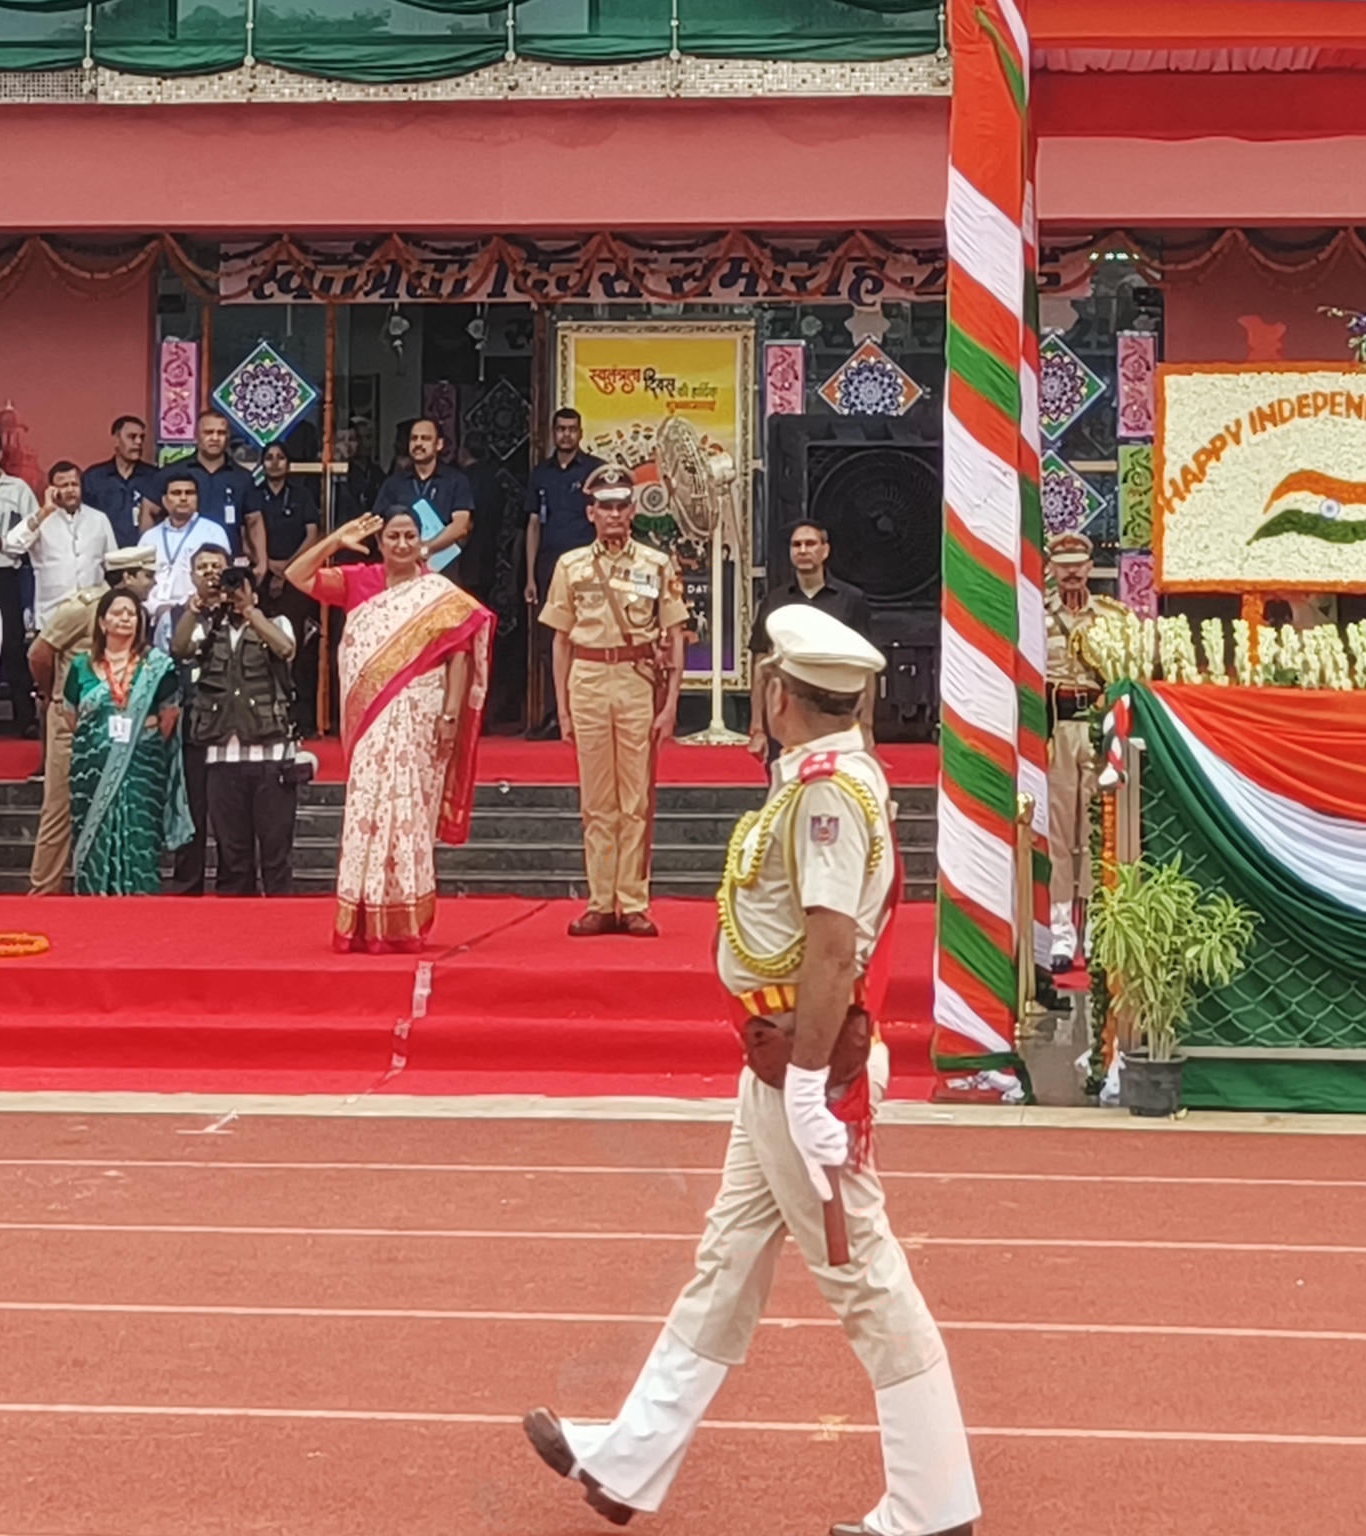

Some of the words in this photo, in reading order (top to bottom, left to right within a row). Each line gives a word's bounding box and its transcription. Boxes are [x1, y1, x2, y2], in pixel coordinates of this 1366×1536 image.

[643, 367, 676, 400] दिवस
[1157, 417, 1242, 514] HAPPY
[687, 584, 709, 594] DAY
